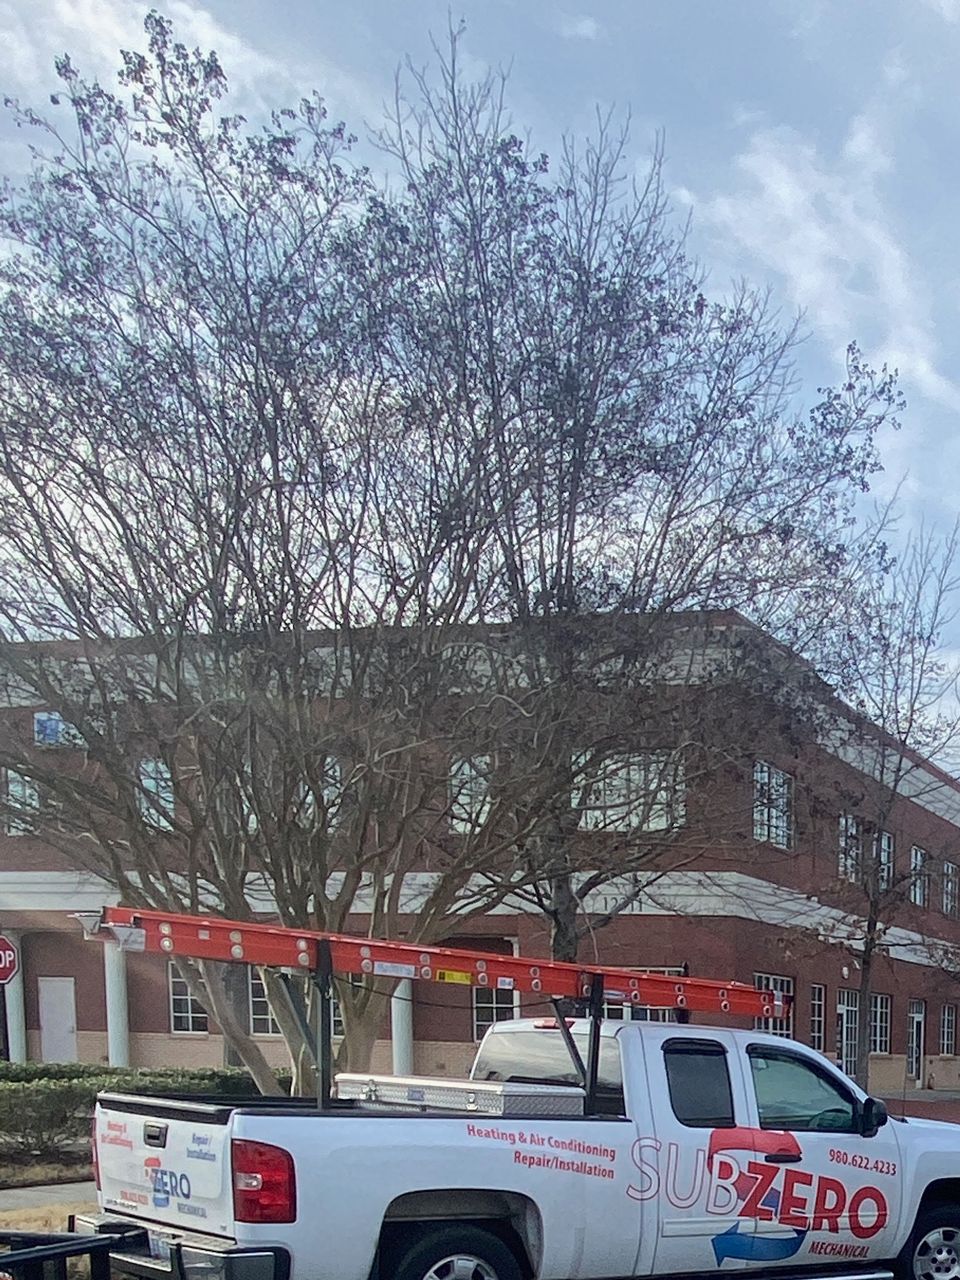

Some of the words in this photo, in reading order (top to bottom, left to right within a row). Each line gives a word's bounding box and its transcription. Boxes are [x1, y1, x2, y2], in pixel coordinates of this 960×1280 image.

[604, 896, 643, 912] 1211
[0, 950, 15, 968] OP
[467, 1124, 516, 1145] Heating
[518, 1132, 527, 1144] &
[529, 1133, 546, 1147] Air
[547, 1136, 616, 1162] Conditioning
[514, 1150, 615, 1180] Repair/Installation
[829, 1148, 897, 1176] 980.622.4233
[808, 1241, 870, 1258] MECHANICAL
